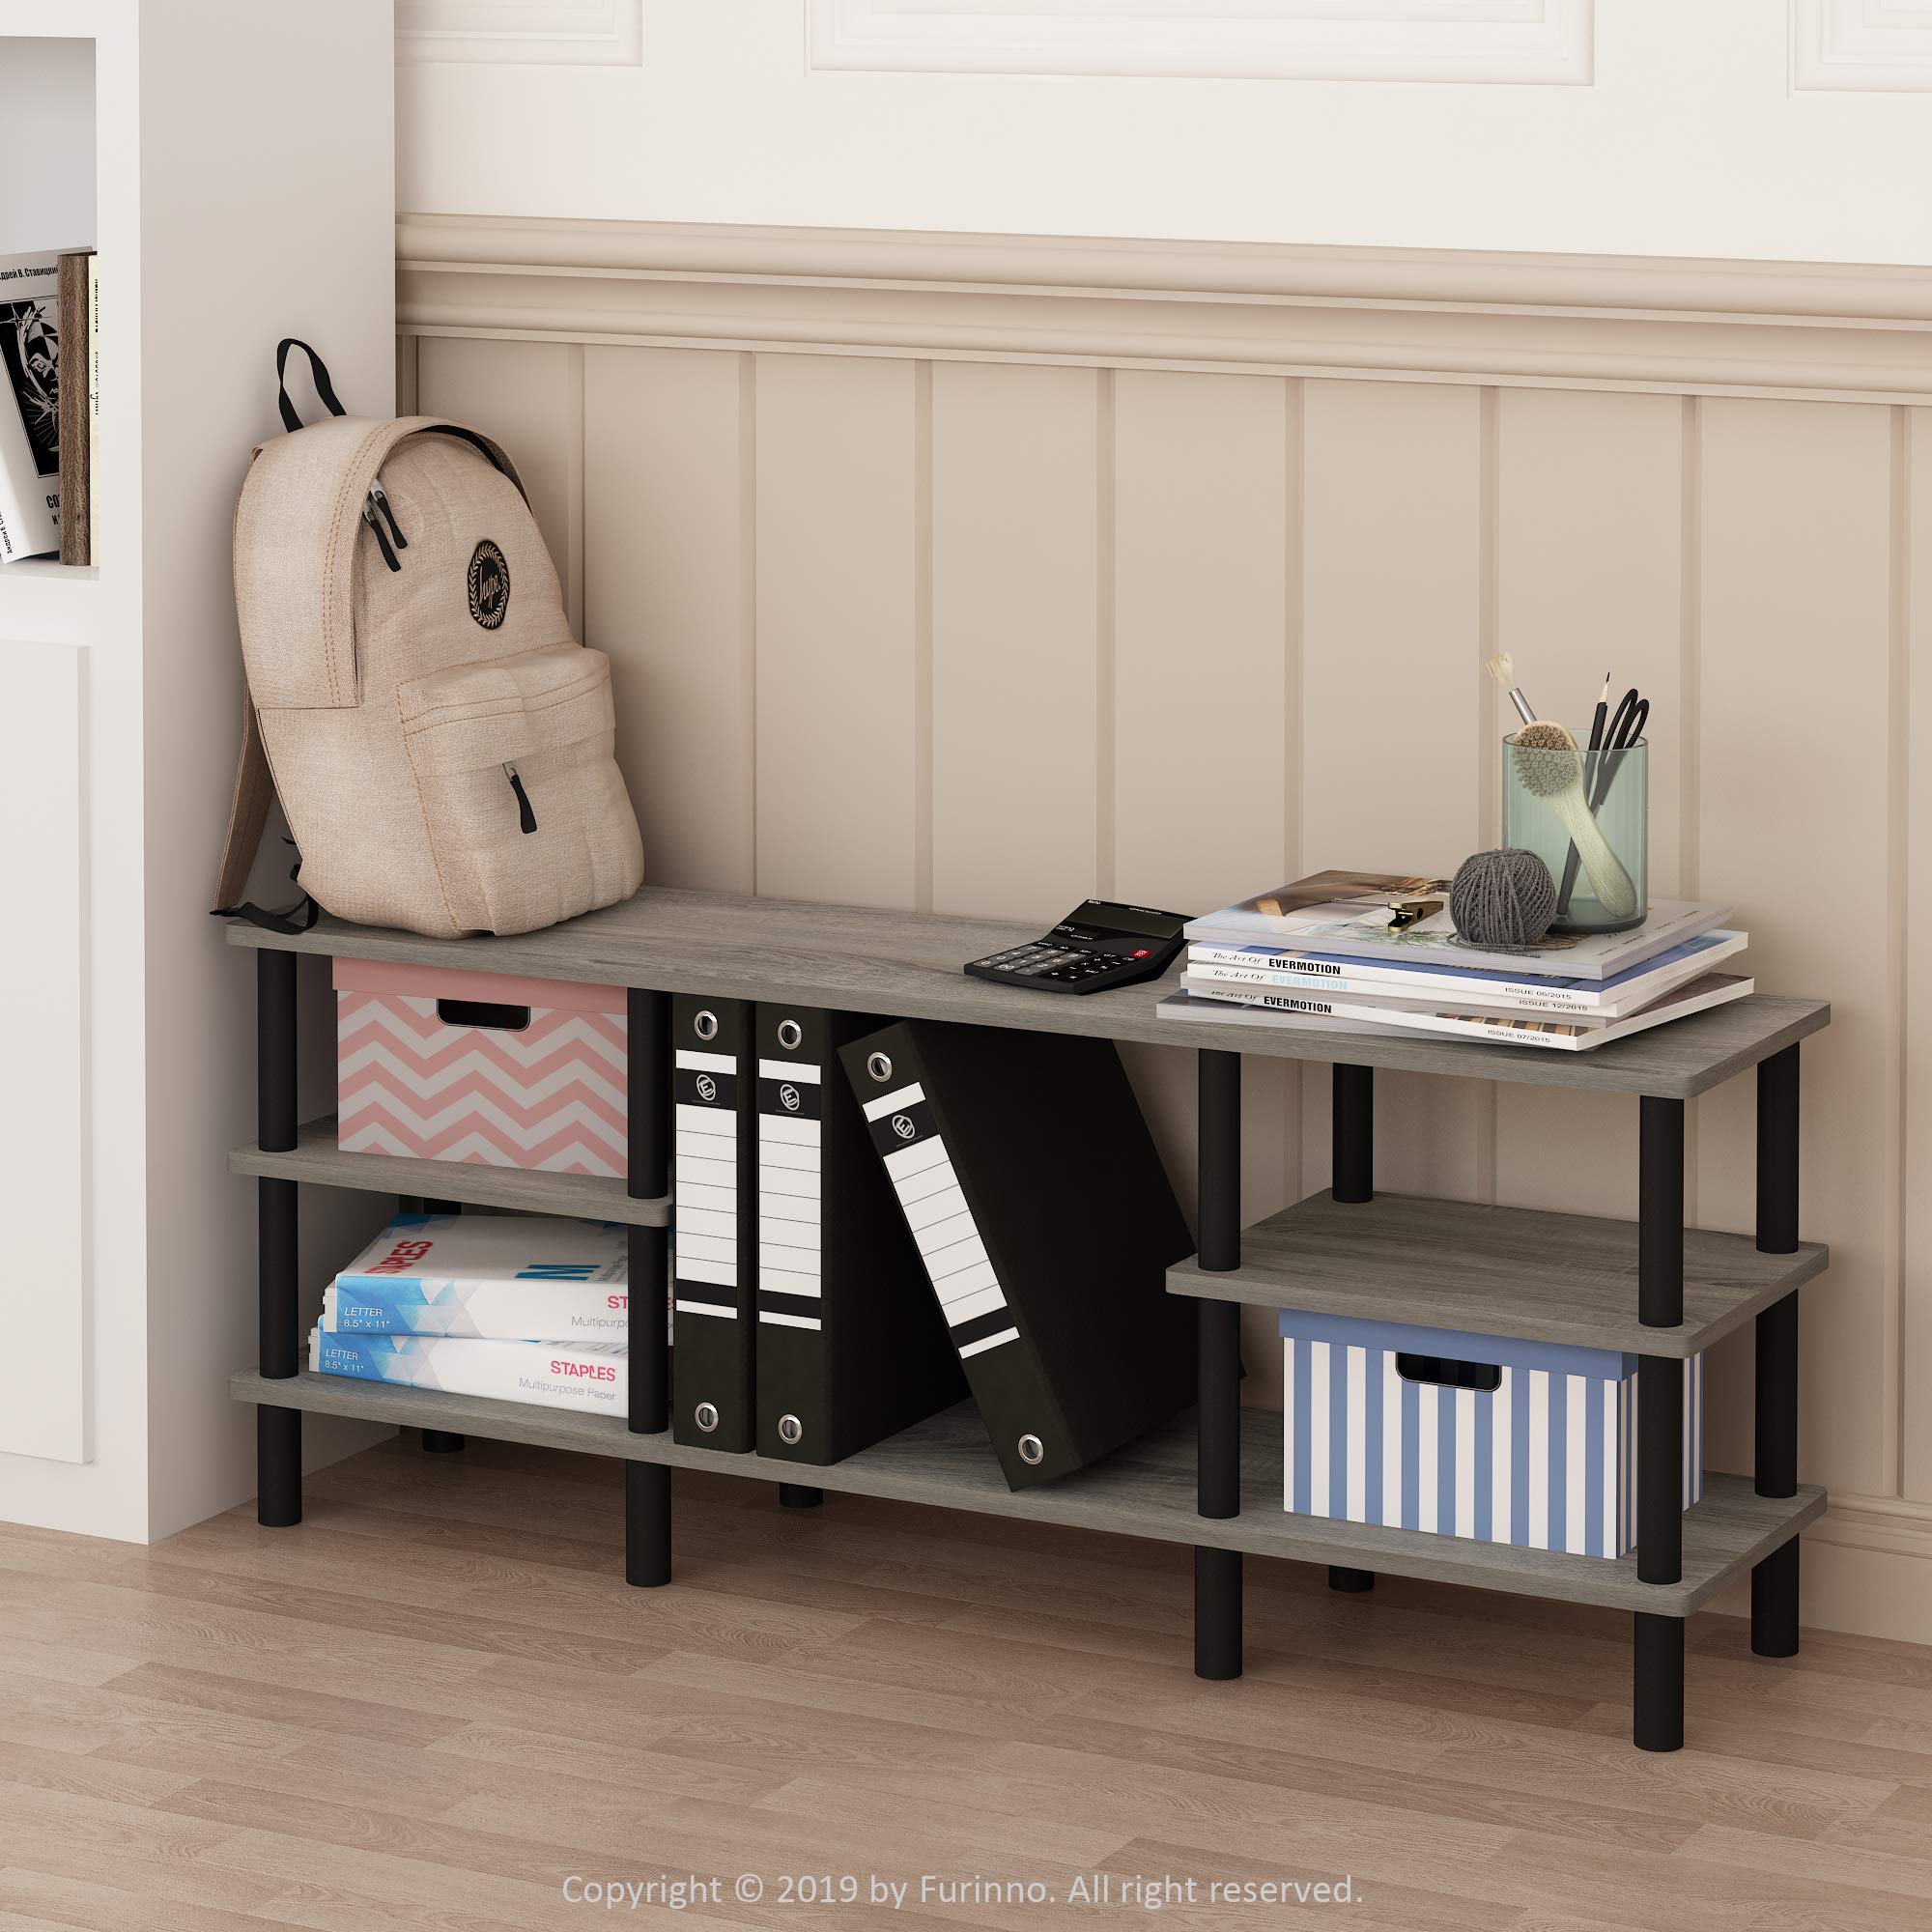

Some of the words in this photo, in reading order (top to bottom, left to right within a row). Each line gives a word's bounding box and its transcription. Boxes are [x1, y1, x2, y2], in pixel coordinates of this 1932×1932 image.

[1212, 952, 1227, 960] The
[1268, 958, 1341, 975] EVERMOTION
[1213, 969, 1228, 978] The
[1272, 975, 1348, 990] EVERMOTION
[1505, 987, 1534, 996] ISSUE
[1536, 991, 1572, 1001] 06/2015
[1264, 996, 1332, 1013] EVERMOTION
[1552, 1003, 1588, 1011] 12/2015
[1488, 1030, 1515, 1038] ISSUE
[1517, 1034, 1550, 1043] 07/2015
[344, 1307, 383, 1317] LETTER
[326, 1349, 358, 1360] LETTER
[551, 1360, 616, 1381] STAPLES
[519, 1378, 584, 1396] Multipurpose
[587, 1387, 616, 1401] Paper
